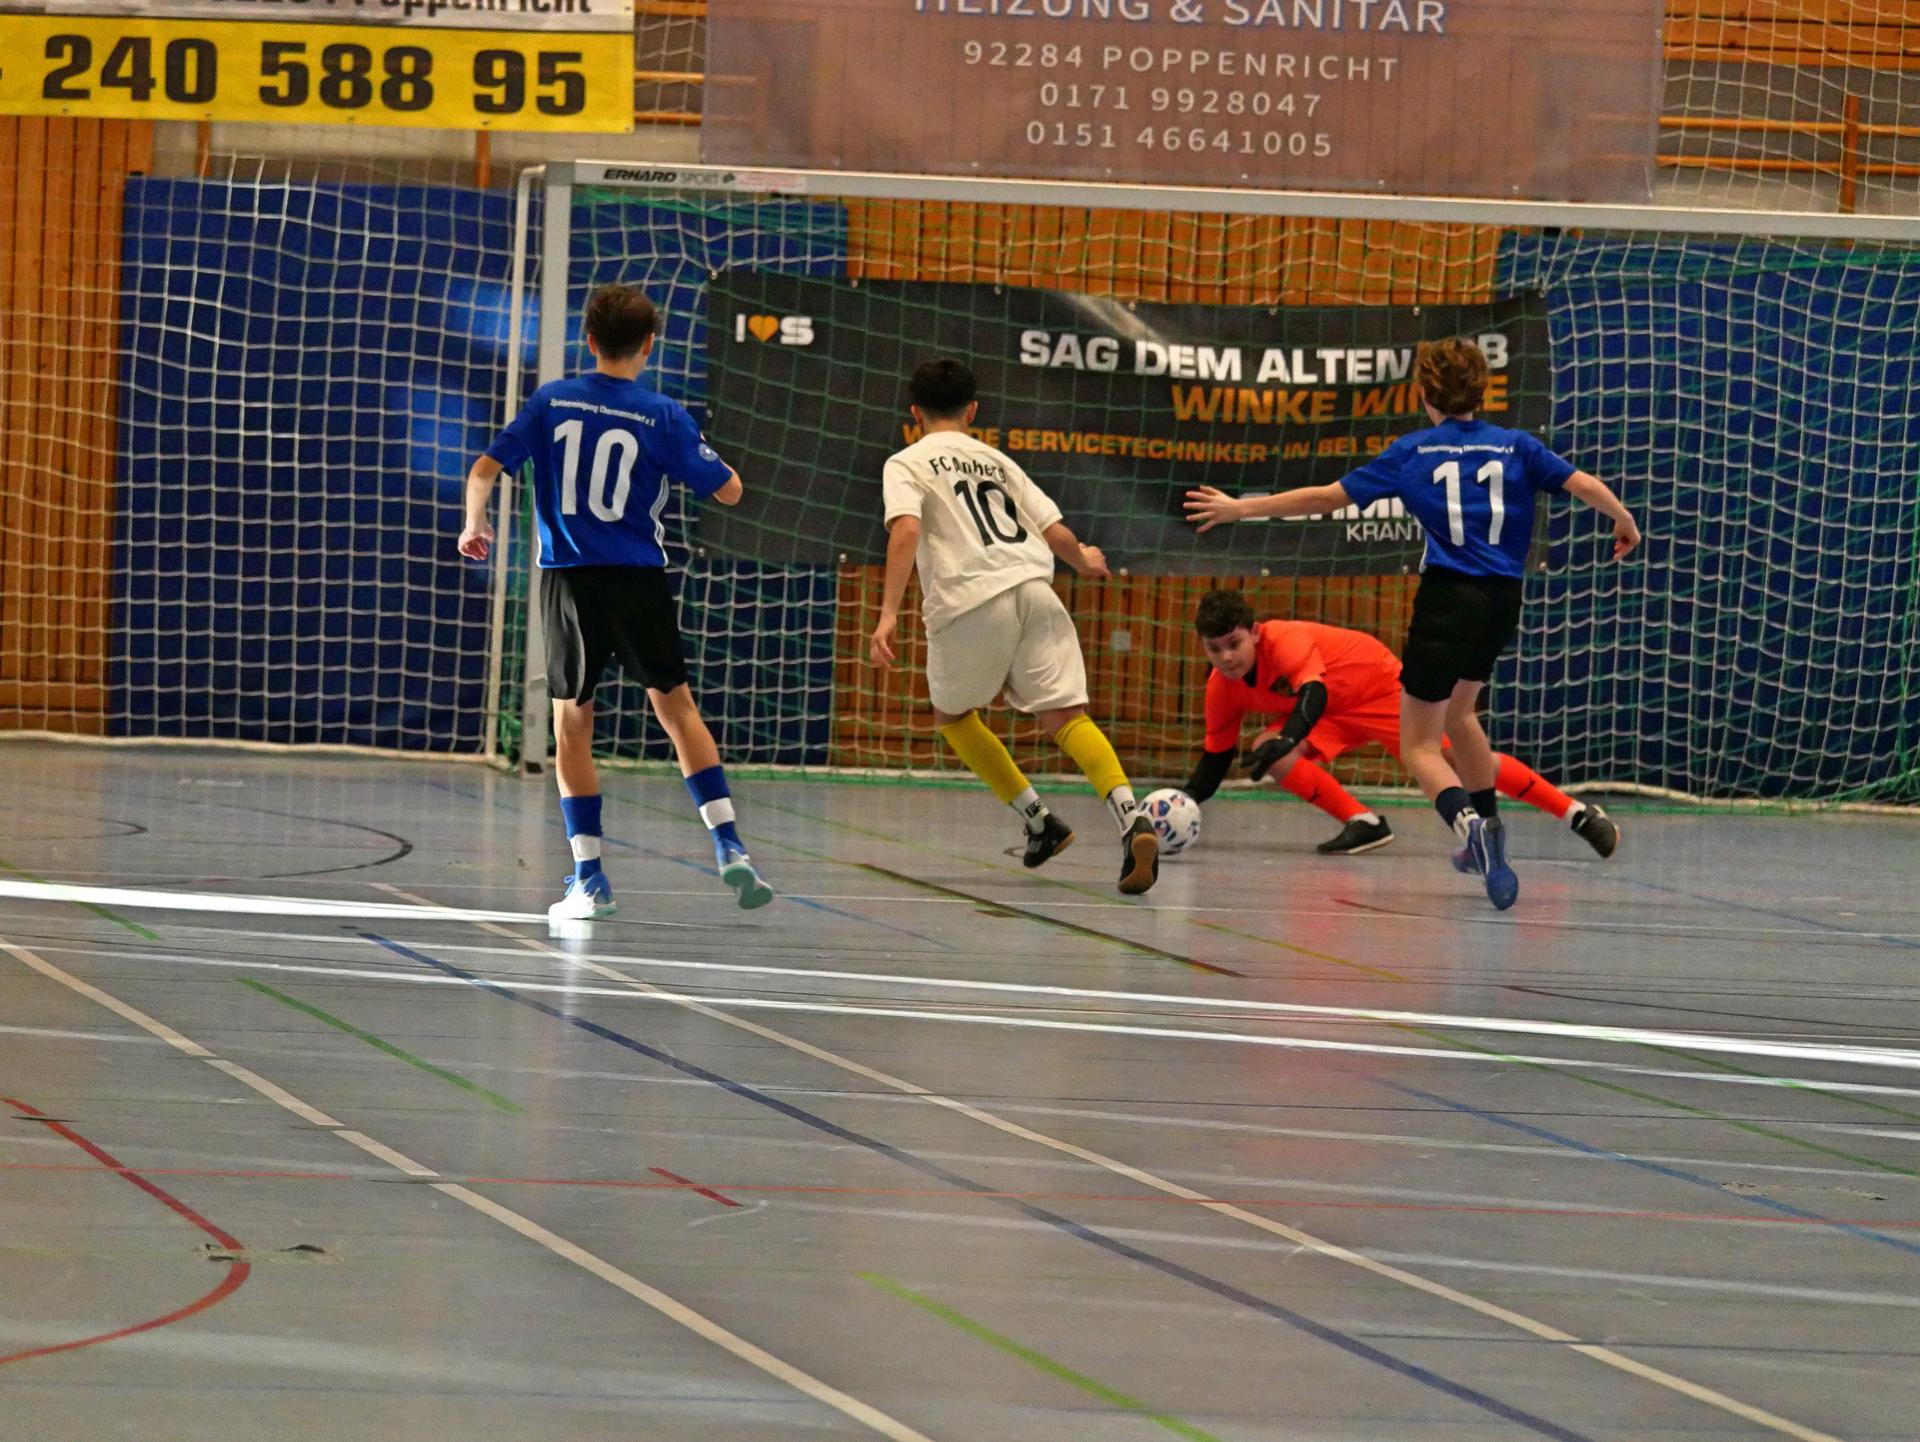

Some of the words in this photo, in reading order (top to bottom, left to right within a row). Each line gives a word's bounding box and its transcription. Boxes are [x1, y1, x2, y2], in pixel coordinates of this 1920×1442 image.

[1168, 0, 1203, 23] &
[42, 34, 218, 104] 240
[258, 41, 434, 112] 588
[473, 48, 587, 116] 95
[963, 41, 1083, 68] 92284
[1102, 46, 1400, 82] POPPENRICHT
[1039, 82, 1130, 109] 0171
[1150, 87, 1322, 118] 9928047
[1025, 121, 1117, 148] 0151
[1136, 127, 1332, 157] 46641005
[603, 168, 677, 183] ERHARD
[1019, 329, 1120, 372] SAG
[1134, 339, 1242, 381] DEM
[1256, 348, 1413, 384] ALTEN
[1171, 384, 1338, 425] WINKE
[929, 456, 952, 475] FC
[1317, 436, 1360, 457] BEI
[553, 419, 639, 523] 10
[953, 480, 1028, 547] 10
[1433, 460, 1505, 547] 11
